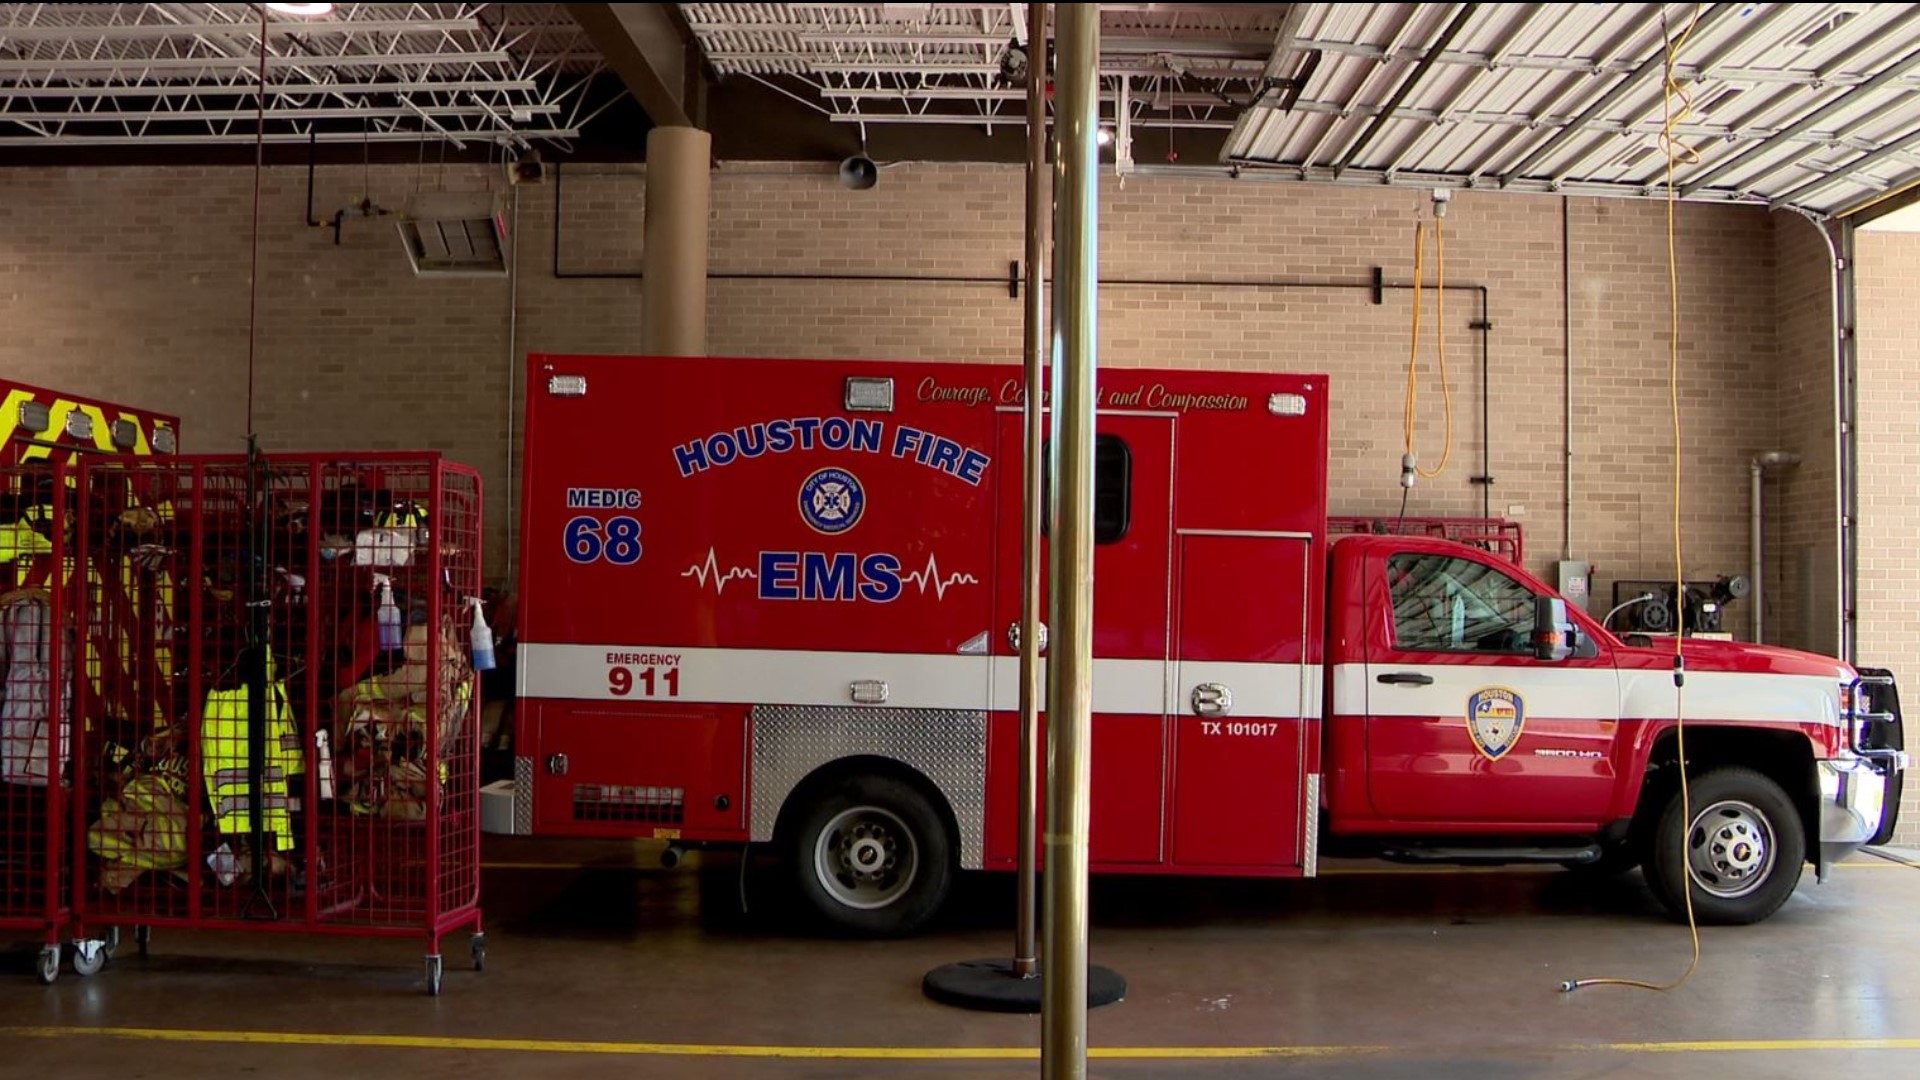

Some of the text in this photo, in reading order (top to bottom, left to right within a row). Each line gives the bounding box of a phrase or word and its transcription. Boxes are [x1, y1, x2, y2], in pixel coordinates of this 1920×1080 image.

[1109, 385, 1145, 406] and
[1146, 383, 1248, 413] Compassion
[673, 418, 990, 486] HOUSTON FIRE
[566, 487, 642, 510] MEDIC
[563, 515, 643, 566] 68
[758, 551, 903, 603] EMS
[606, 652, 681, 666] EMERGENCY
[608, 666, 679, 697] 911
[1200, 721, 1278, 737] TX 101017
